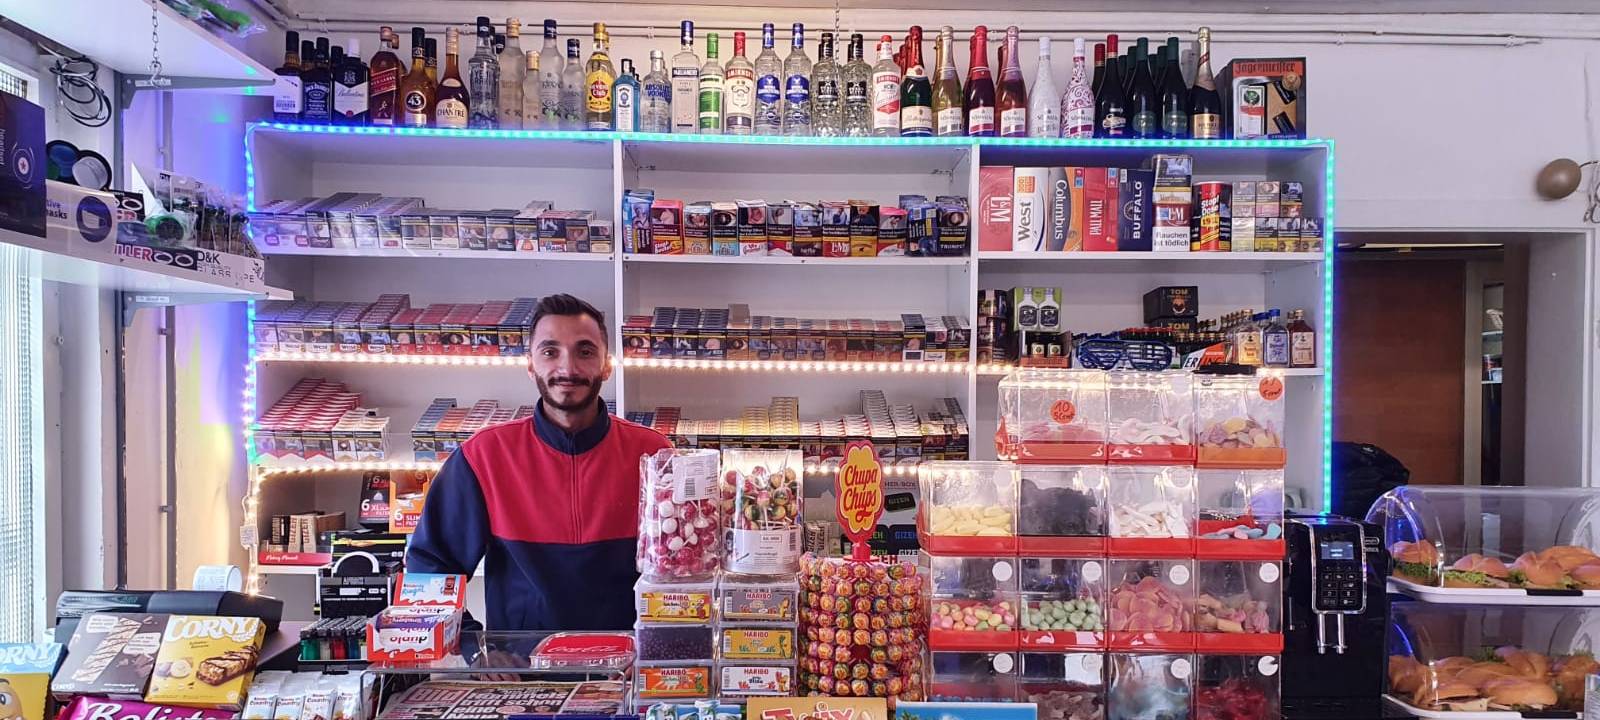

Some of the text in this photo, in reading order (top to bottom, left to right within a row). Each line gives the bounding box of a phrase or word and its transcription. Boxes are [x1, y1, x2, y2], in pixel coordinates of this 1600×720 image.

[407, 95, 421, 106] 43
[46, 209, 68, 219] asks
[1055, 180, 1067, 240] Columbus
[1089, 200, 1102, 236] PALL MALL
[1133, 181, 1143, 239] BUFFALO
[1168, 207, 1184, 220] L&M
[1018, 201, 1031, 242] West
[1168, 322, 1190, 330] TOM
[845, 465, 878, 491] Chupa
[361, 499, 371, 512] 6
[843, 488, 877, 512] Chups
[395, 509, 403, 521] 6
[746, 592, 771, 600] HARIBO
[163, 616, 257, 643] CORNY
[390, 636, 427, 644] duplo
[0, 643, 59, 667] ORNY
